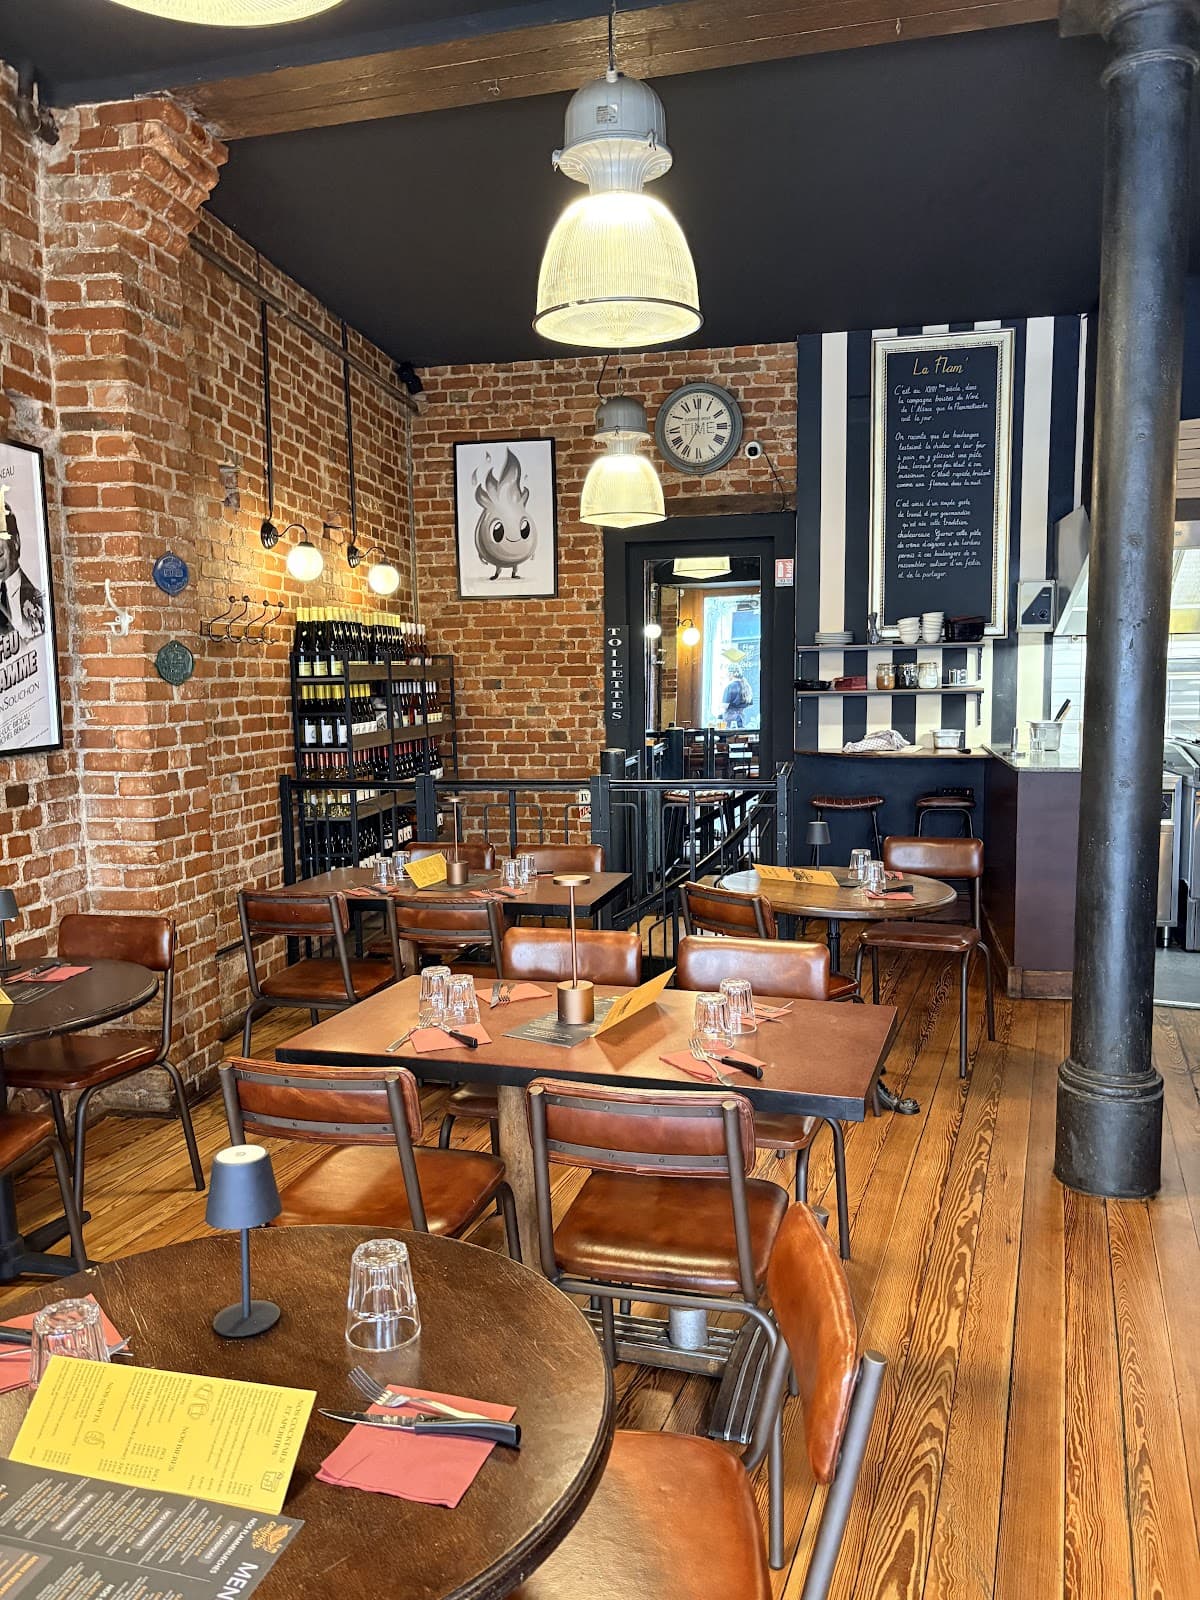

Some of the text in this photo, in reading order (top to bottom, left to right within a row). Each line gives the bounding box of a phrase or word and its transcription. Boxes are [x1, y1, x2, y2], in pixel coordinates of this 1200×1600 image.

[913, 358, 929, 375] La
[607, 627, 624, 721] TOILETTES
[243, 1517, 258, 1529] NOS
